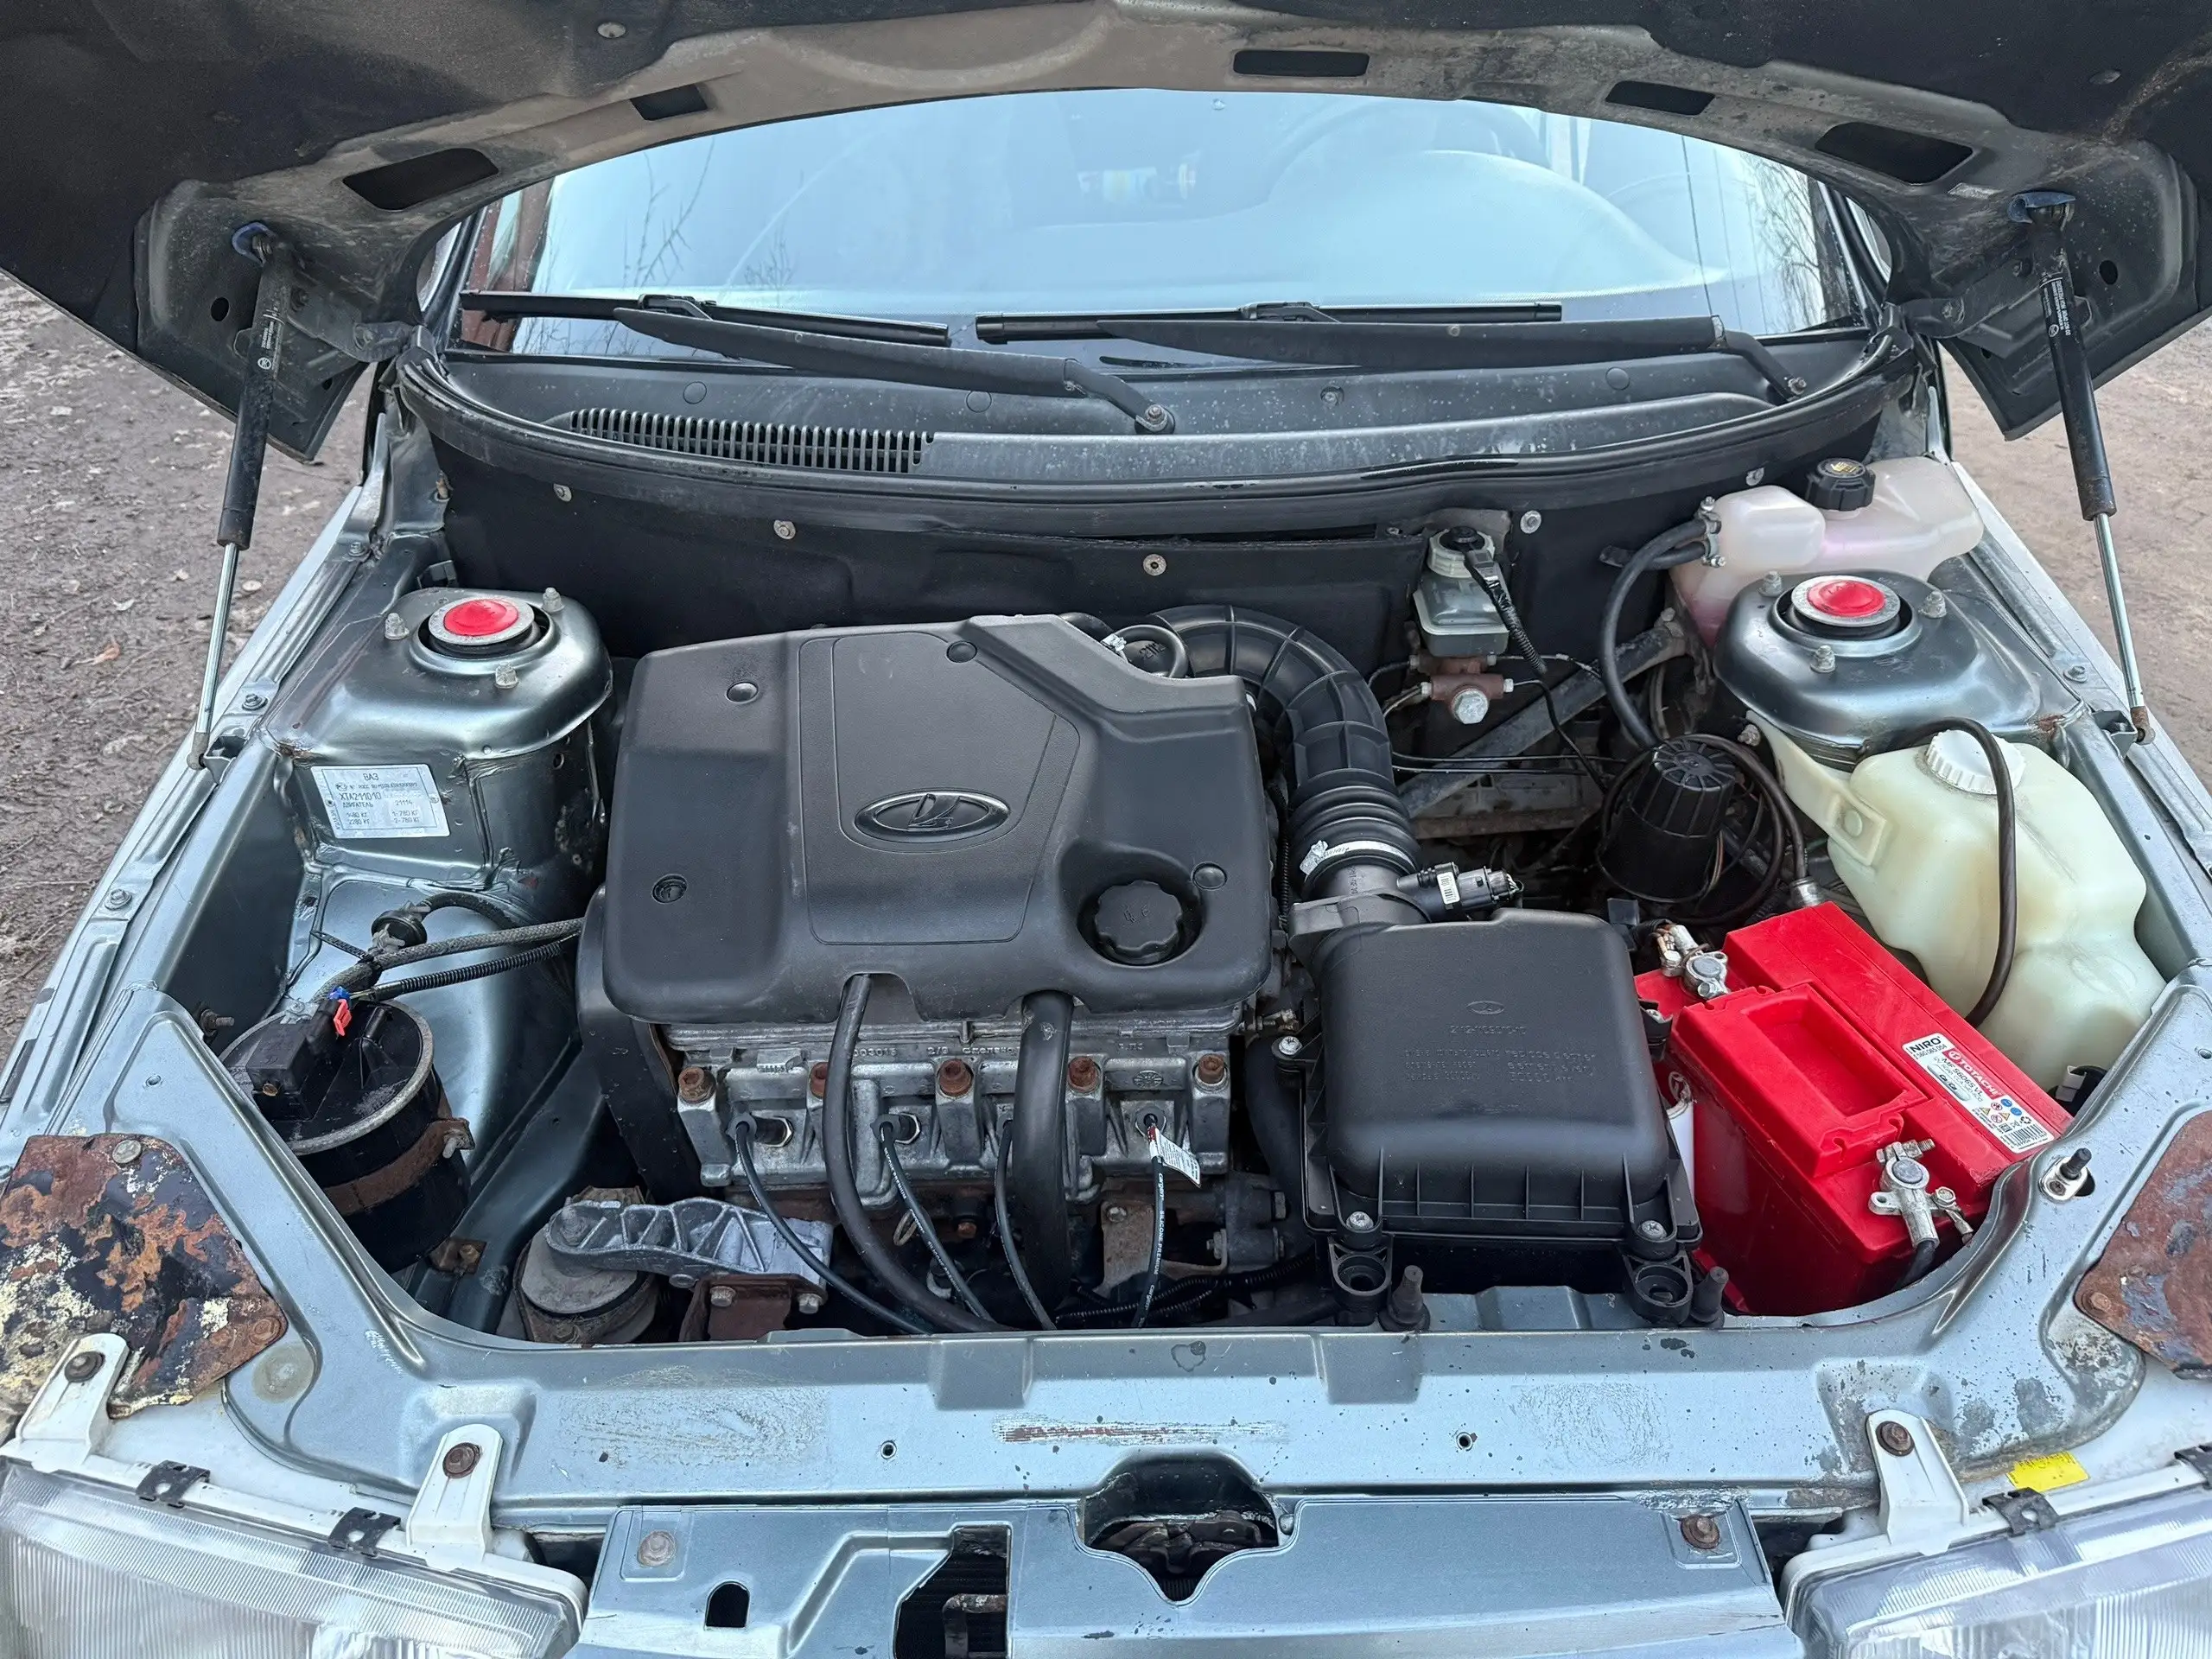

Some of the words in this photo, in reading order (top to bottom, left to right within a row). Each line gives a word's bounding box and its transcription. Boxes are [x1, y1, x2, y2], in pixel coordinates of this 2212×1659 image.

[1909, 1038, 1941, 1052] NIRO
[1959, 1058, 1998, 1096] TOTACHI
[1154, 1243, 1163, 1275] PREMIUM
